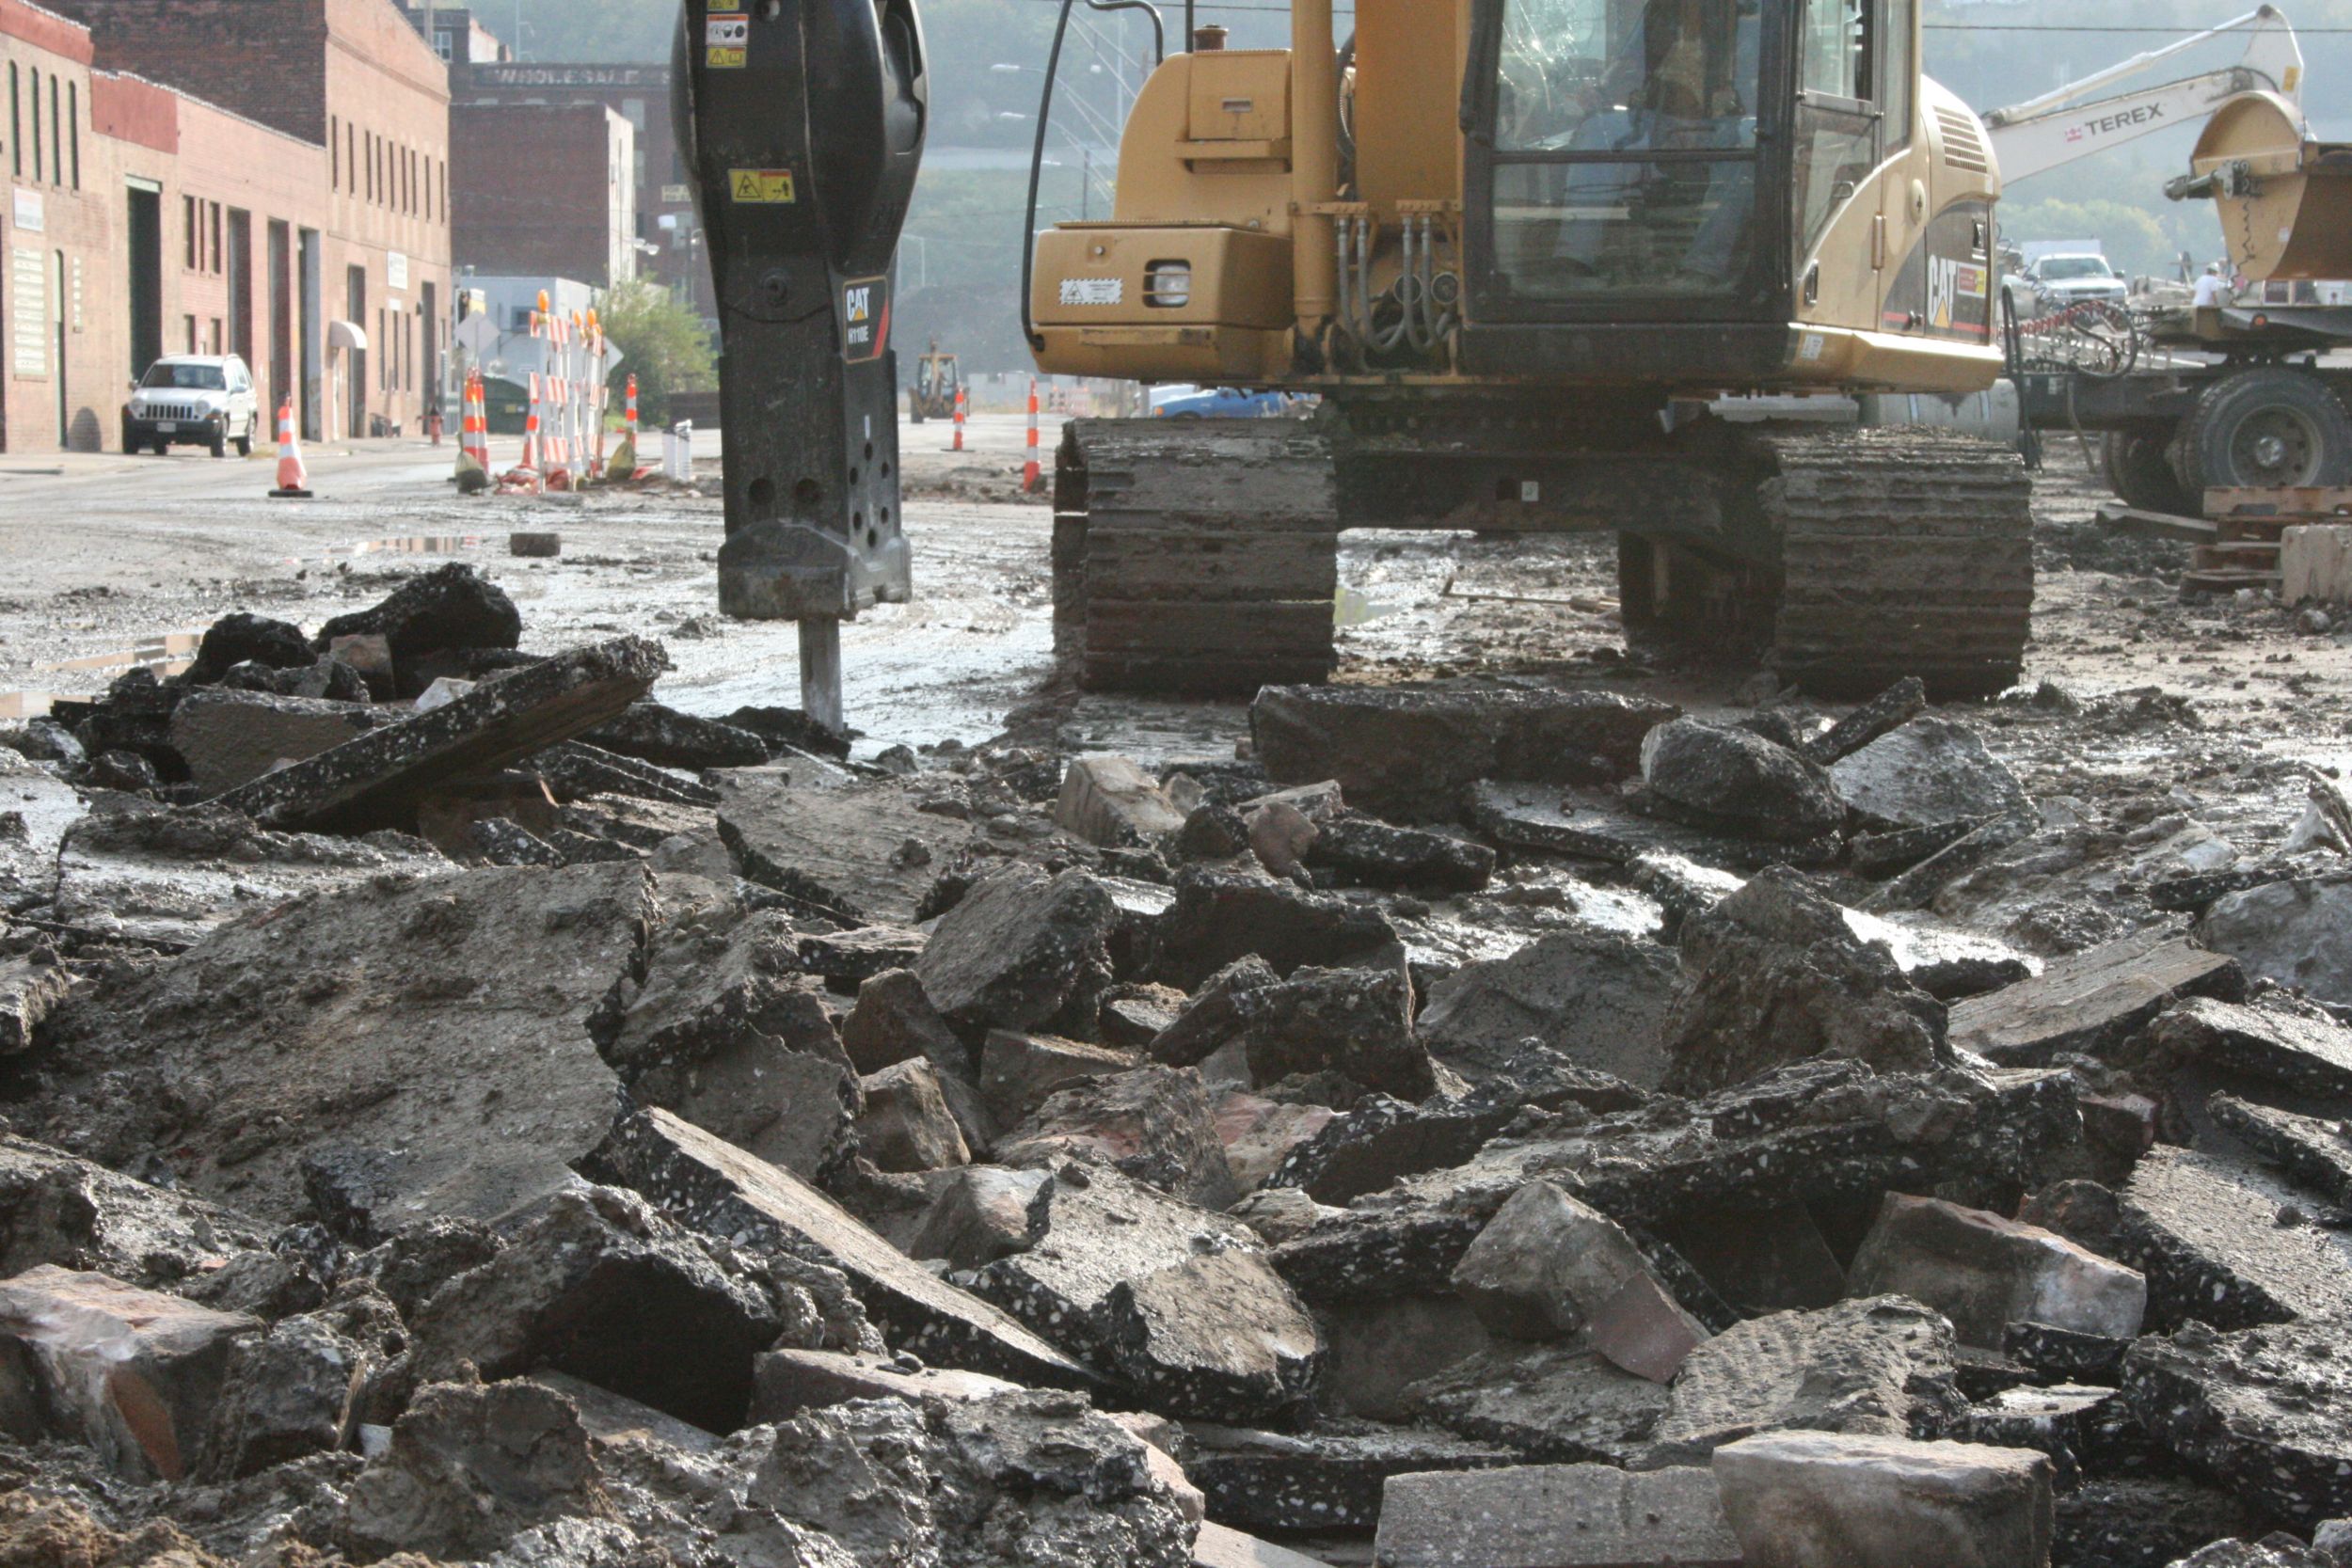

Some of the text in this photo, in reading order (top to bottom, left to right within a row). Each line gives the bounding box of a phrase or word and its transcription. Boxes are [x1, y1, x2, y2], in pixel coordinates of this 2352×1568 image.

[496, 69, 639, 85] WHOLESALE
[2085, 103, 2164, 135] TEREX
[847, 287, 869, 321] CAT
[1928, 254, 1957, 328] CAT
